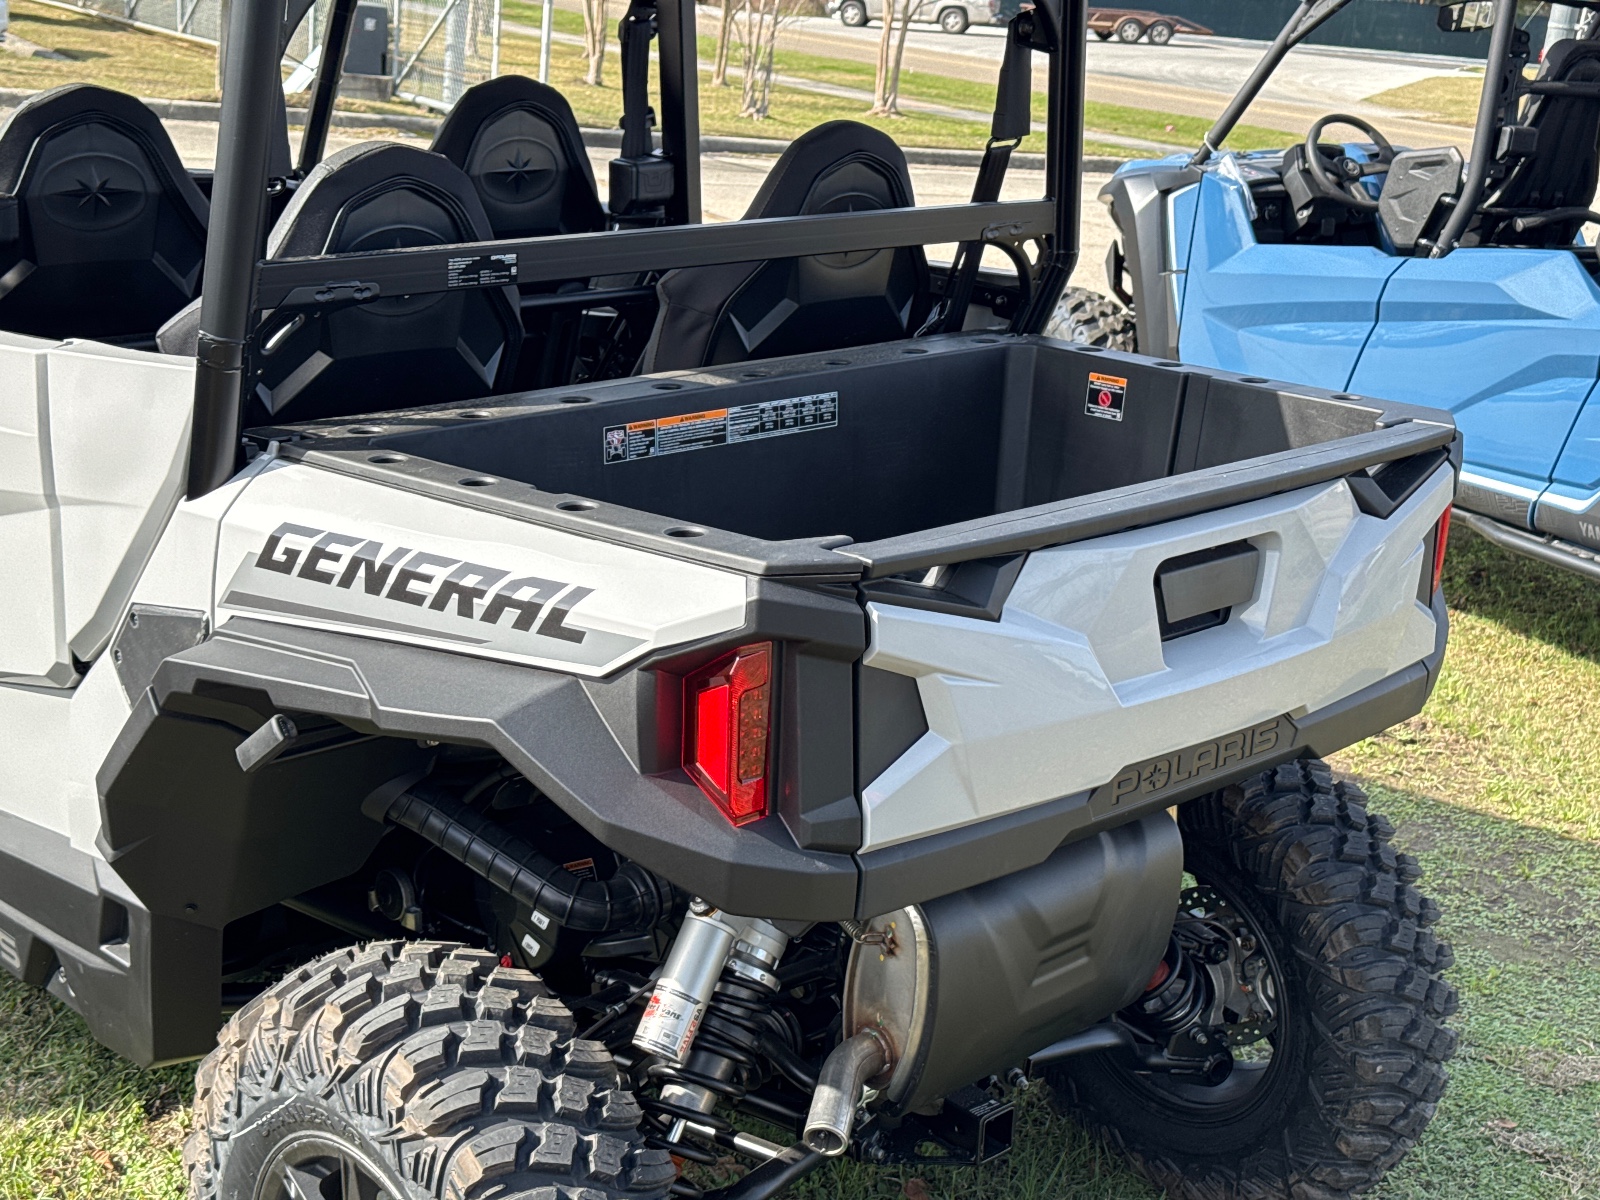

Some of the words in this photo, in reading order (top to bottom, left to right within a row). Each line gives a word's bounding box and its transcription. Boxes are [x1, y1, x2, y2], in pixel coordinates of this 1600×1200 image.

[634, 421, 654, 429] WARNING
[254, 522, 596, 644] GENERAL
[1112, 720, 1280, 806] POLARIS
